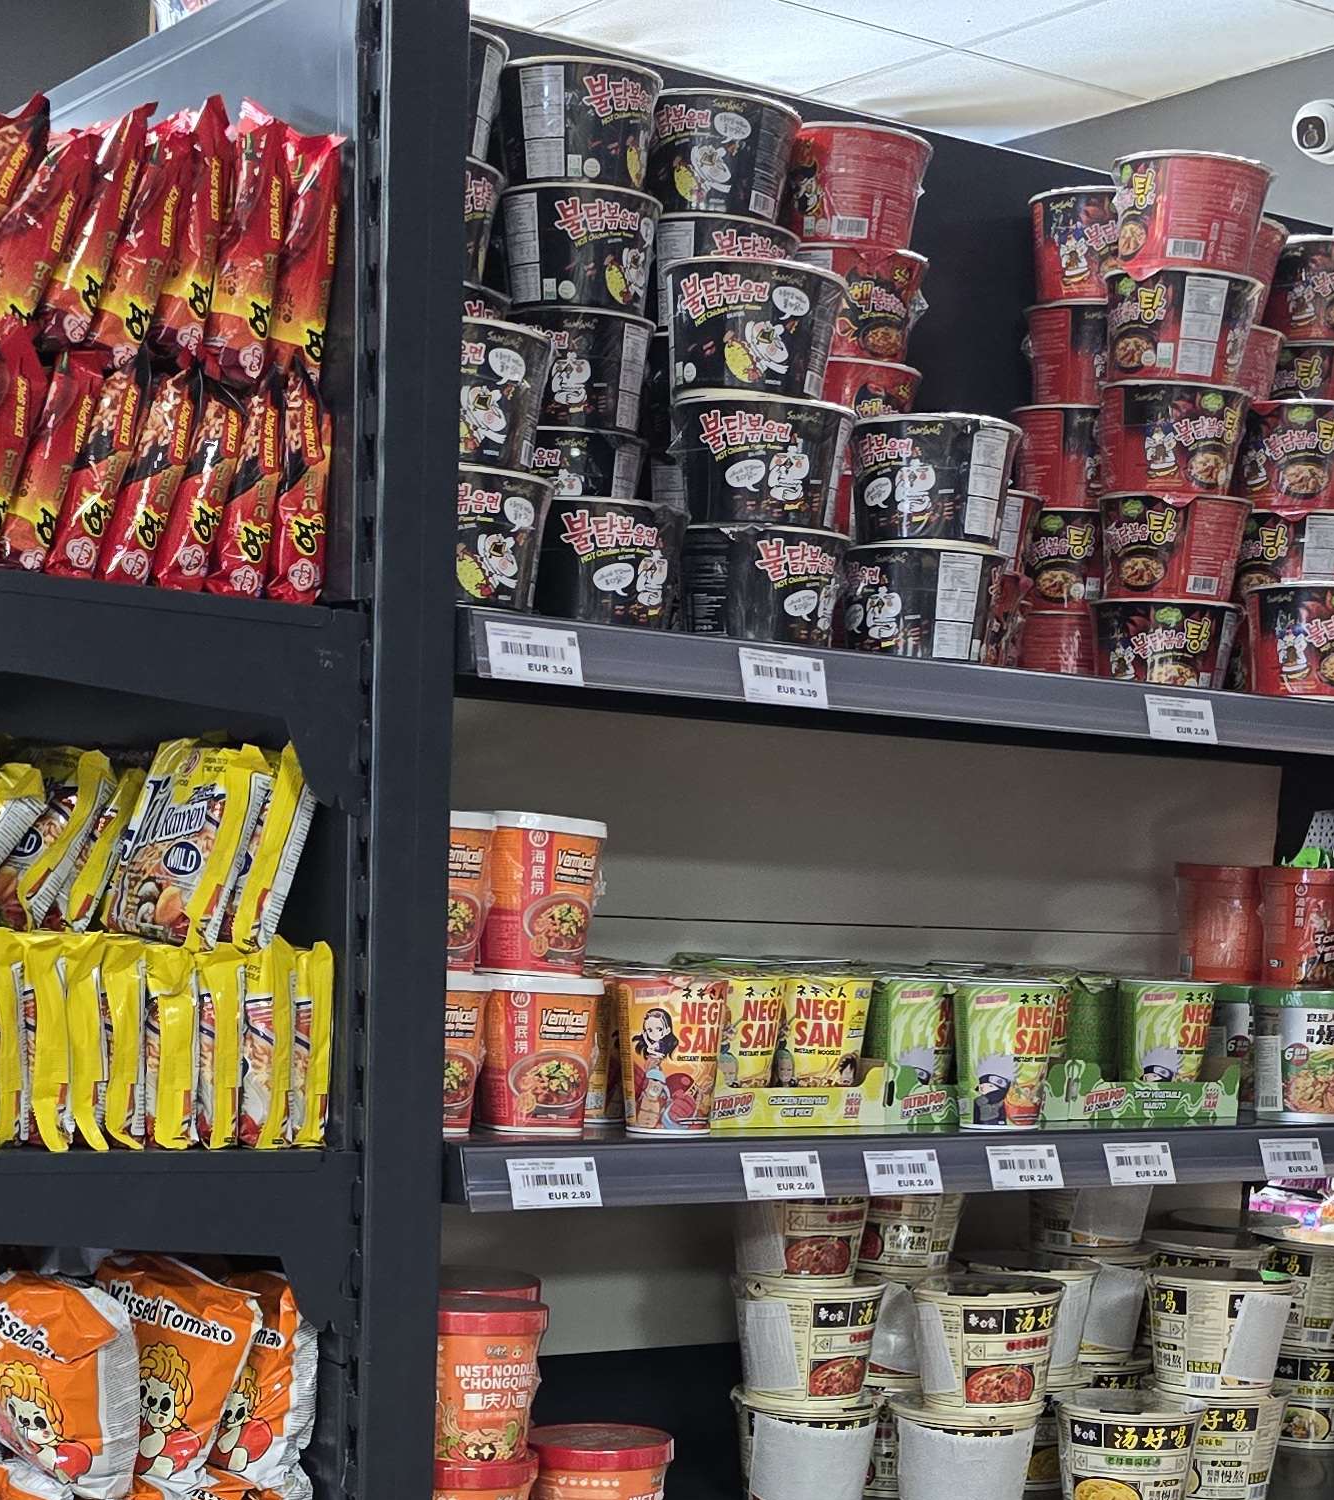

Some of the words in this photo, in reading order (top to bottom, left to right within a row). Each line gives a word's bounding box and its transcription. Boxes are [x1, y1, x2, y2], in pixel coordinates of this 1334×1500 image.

[51, 220, 67, 254] EXTRA
[60, 190, 77, 222] SPICY
[555, 197, 640, 239] 불닭볶음면
[680, 275, 770, 316] 불닭볶음면
[304, 398, 317, 428] SPICY
[304, 429, 317, 460] EXTRA
[699, 410, 791, 456] 불닭볶음면
[561, 512, 658, 554] 불닭볶음면
[528, 663, 549, 672] EUR
[552, 665, 573, 675] 3.59
[777, 685, 796, 694] EUR
[163, 802, 208, 839] Ramen
[167, 846, 197, 872] MILD
[556, 849, 595, 872] Vermicelli
[529, 848, 547, 896] 海底捞
[541, 1008, 589, 1029] Vermicelli
[795, 998, 846, 1022] NEGI
[512, 1011, 529, 1056] 海底捞
[793, 1023, 844, 1047] SAN
[903, 1094, 927, 1112] ULTRA
[927, 1091, 946, 1107] POP
[1019, 1174, 1036, 1182] EUR
[1135, 1169, 1152, 1178] EUR
[1288, 1165, 1303, 1174] EUR
[777, 1183, 794, 1191] EUR
[796, 1182, 815, 1191] 2.69
[898, 1179, 914, 1187] EUR
[916, 1179, 934, 1187] 2.69
[548, 1192, 569, 1200] EUR
[571, 1191, 591, 1200] 2.89
[109, 1281, 161, 1324] Kissed
[161, 1303, 233, 1344] Tomato
[454, 1363, 490, 1377] INST
[460, 1375, 533, 1390] CHONGQING
[463, 1392, 528, 1411] 重庆小面
[1113, 1423, 1188, 1450] 汤好喝
